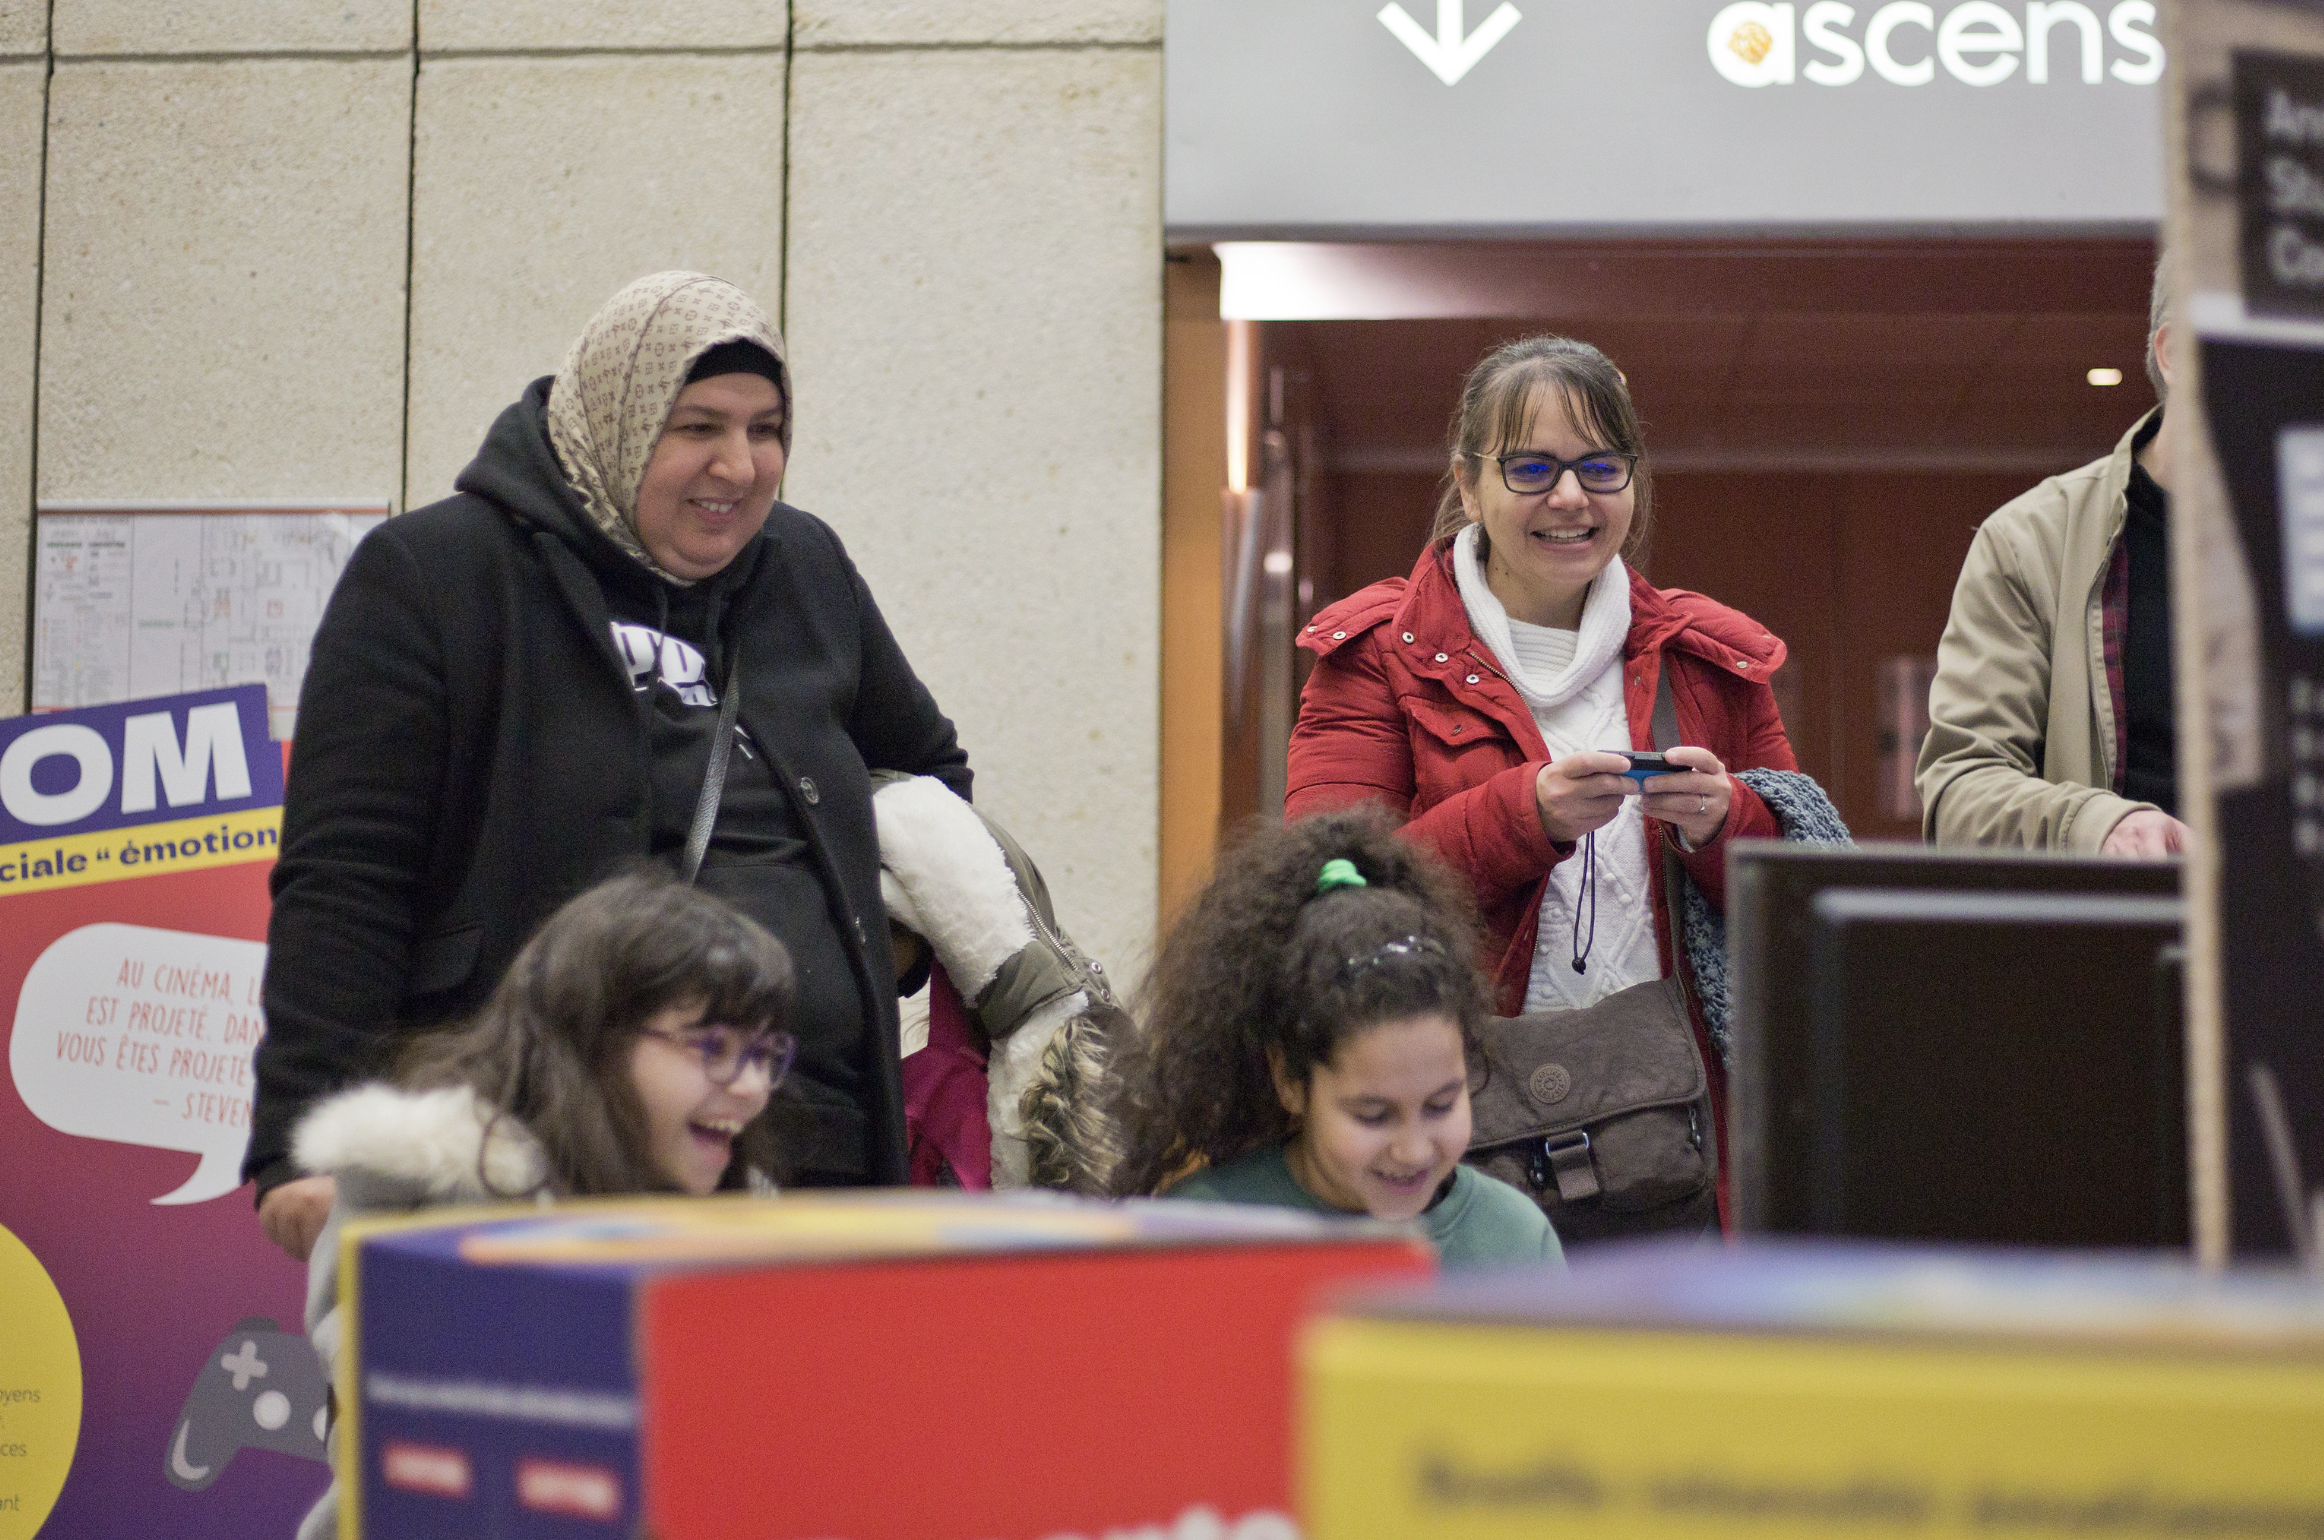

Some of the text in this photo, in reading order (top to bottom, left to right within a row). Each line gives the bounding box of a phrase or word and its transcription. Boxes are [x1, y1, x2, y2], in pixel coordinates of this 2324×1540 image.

[1707, 0, 2166, 88] ascens
[0, 702, 252, 826] OM
[0, 849, 88, 883] ciale
[116, 958, 144, 988] AU
[86, 996, 119, 1026] EST
[56, 1030, 106, 1067] VOUS
[116, 1034, 160, 1074] ÊTES
